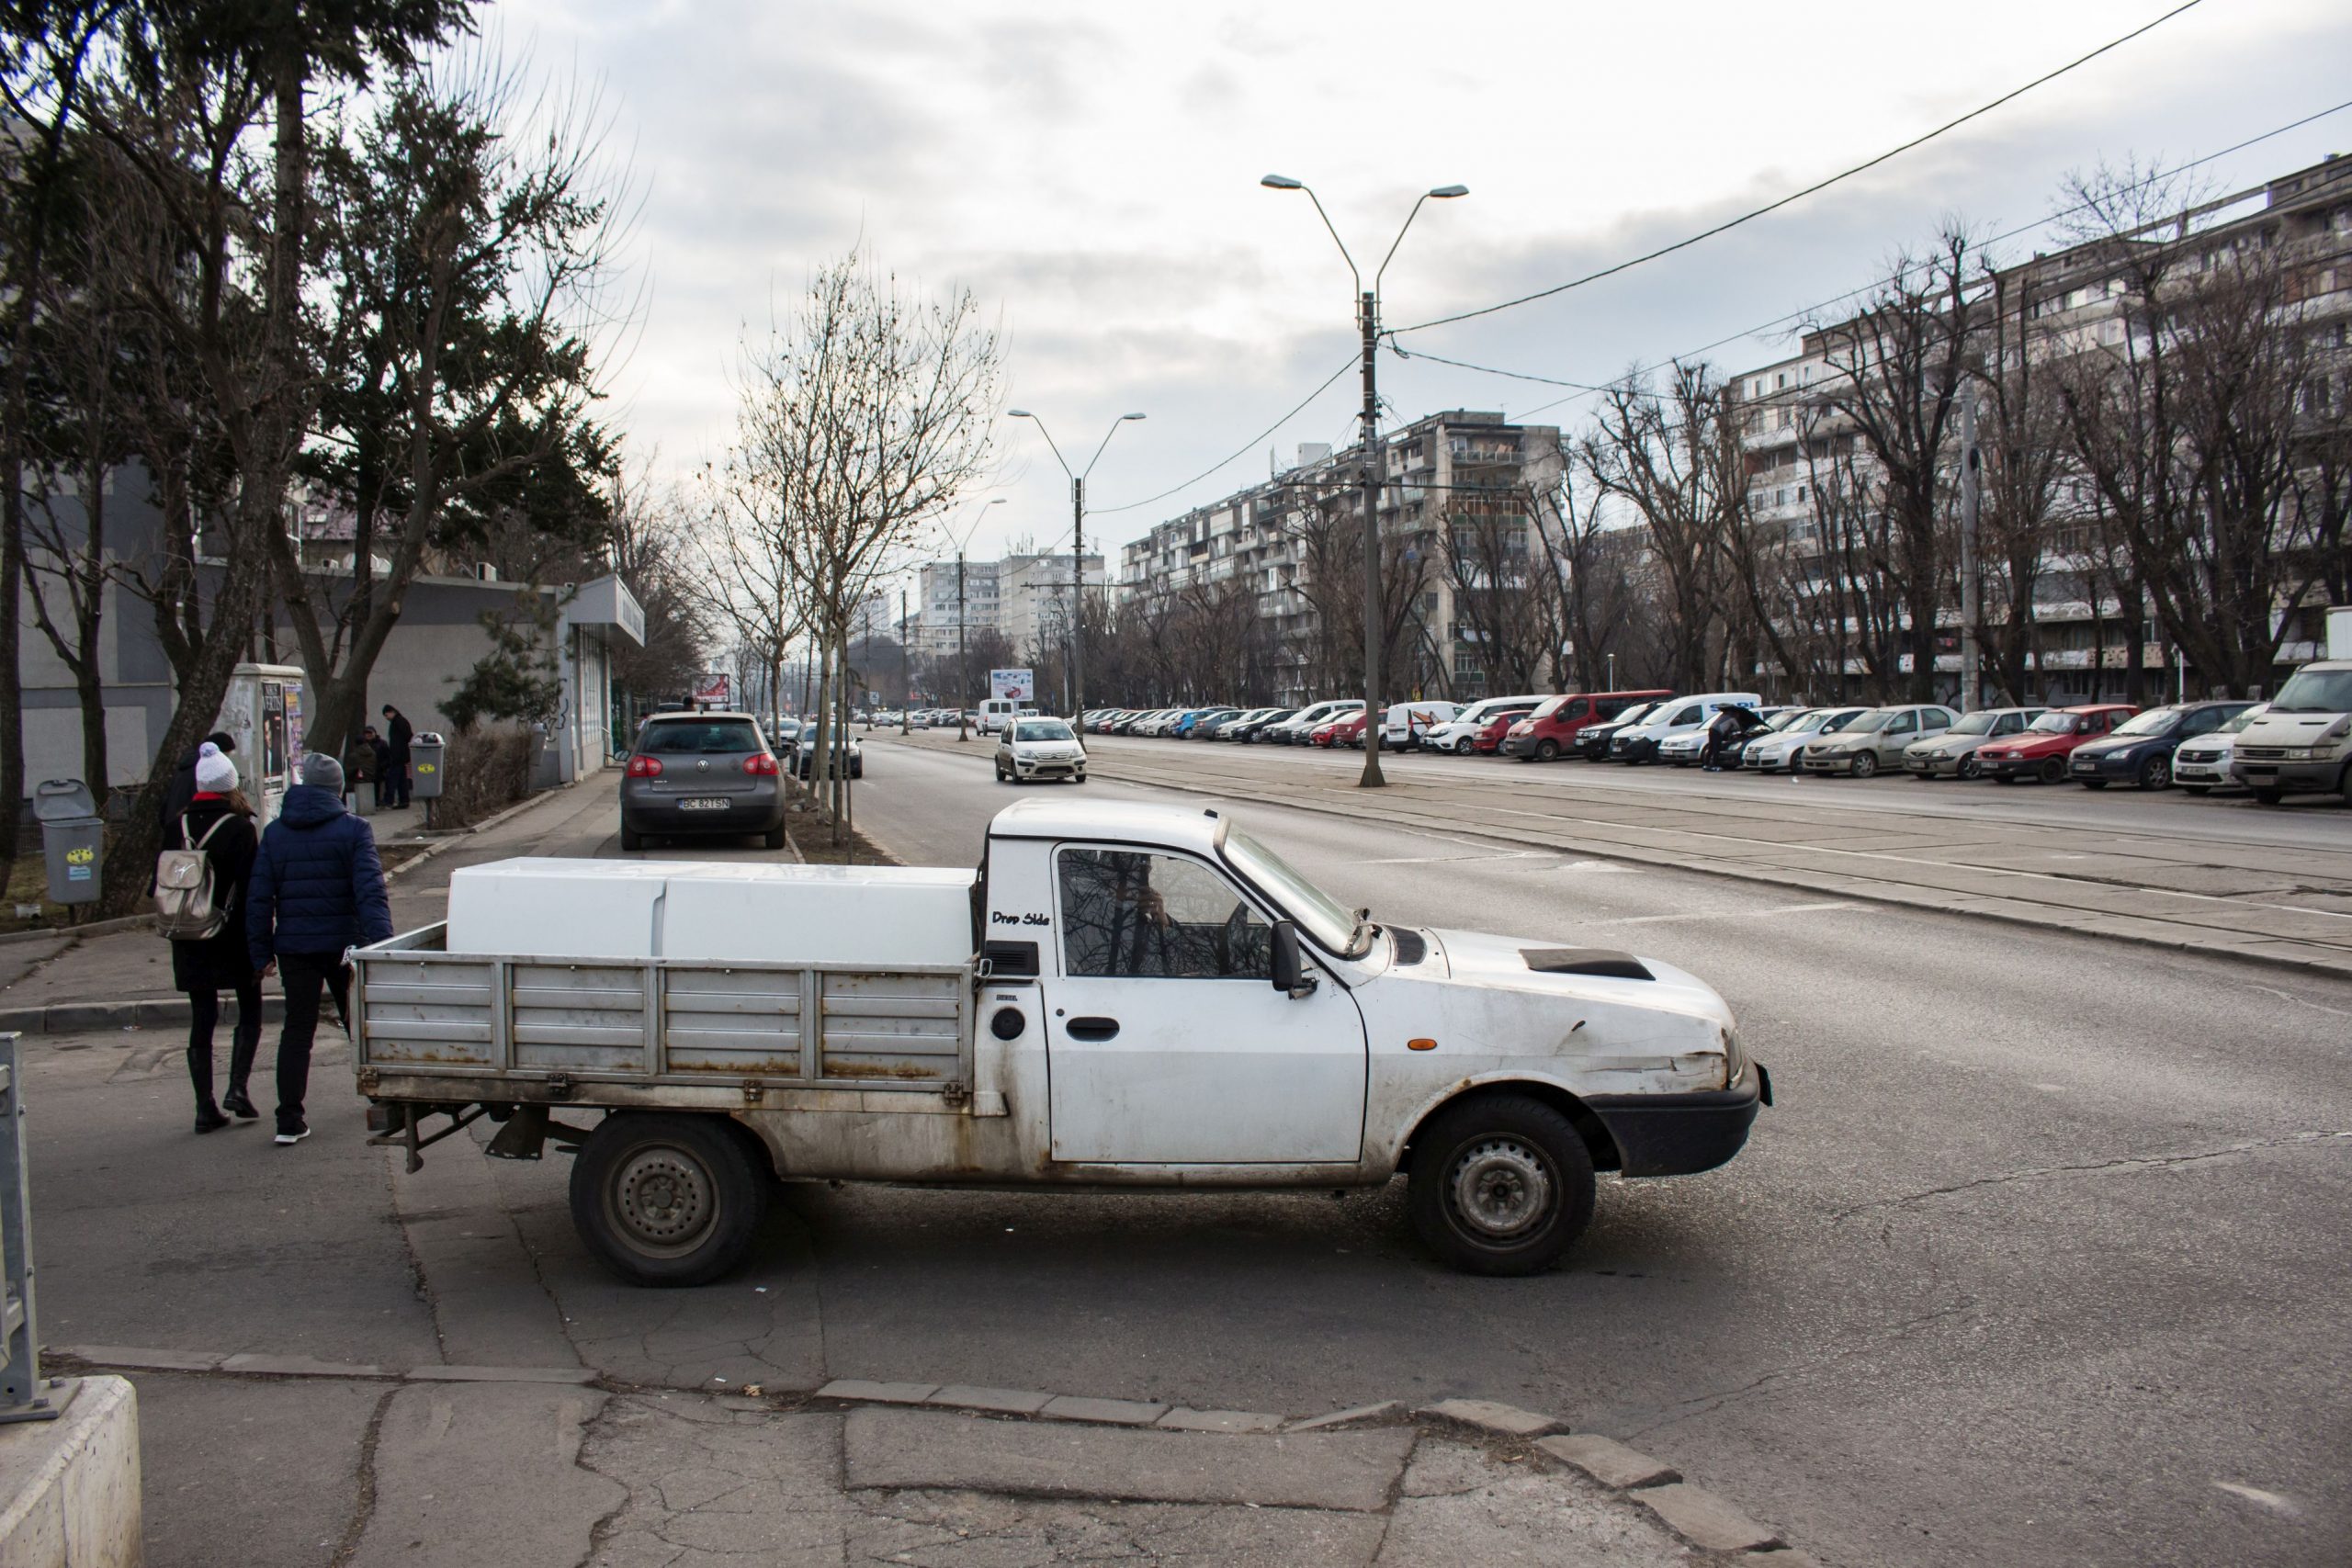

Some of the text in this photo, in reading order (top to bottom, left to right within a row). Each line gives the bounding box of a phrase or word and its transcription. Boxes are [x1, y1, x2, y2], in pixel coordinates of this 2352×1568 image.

[684, 798, 696, 808] BC
[992, 911, 1050, 926] Drop Side
